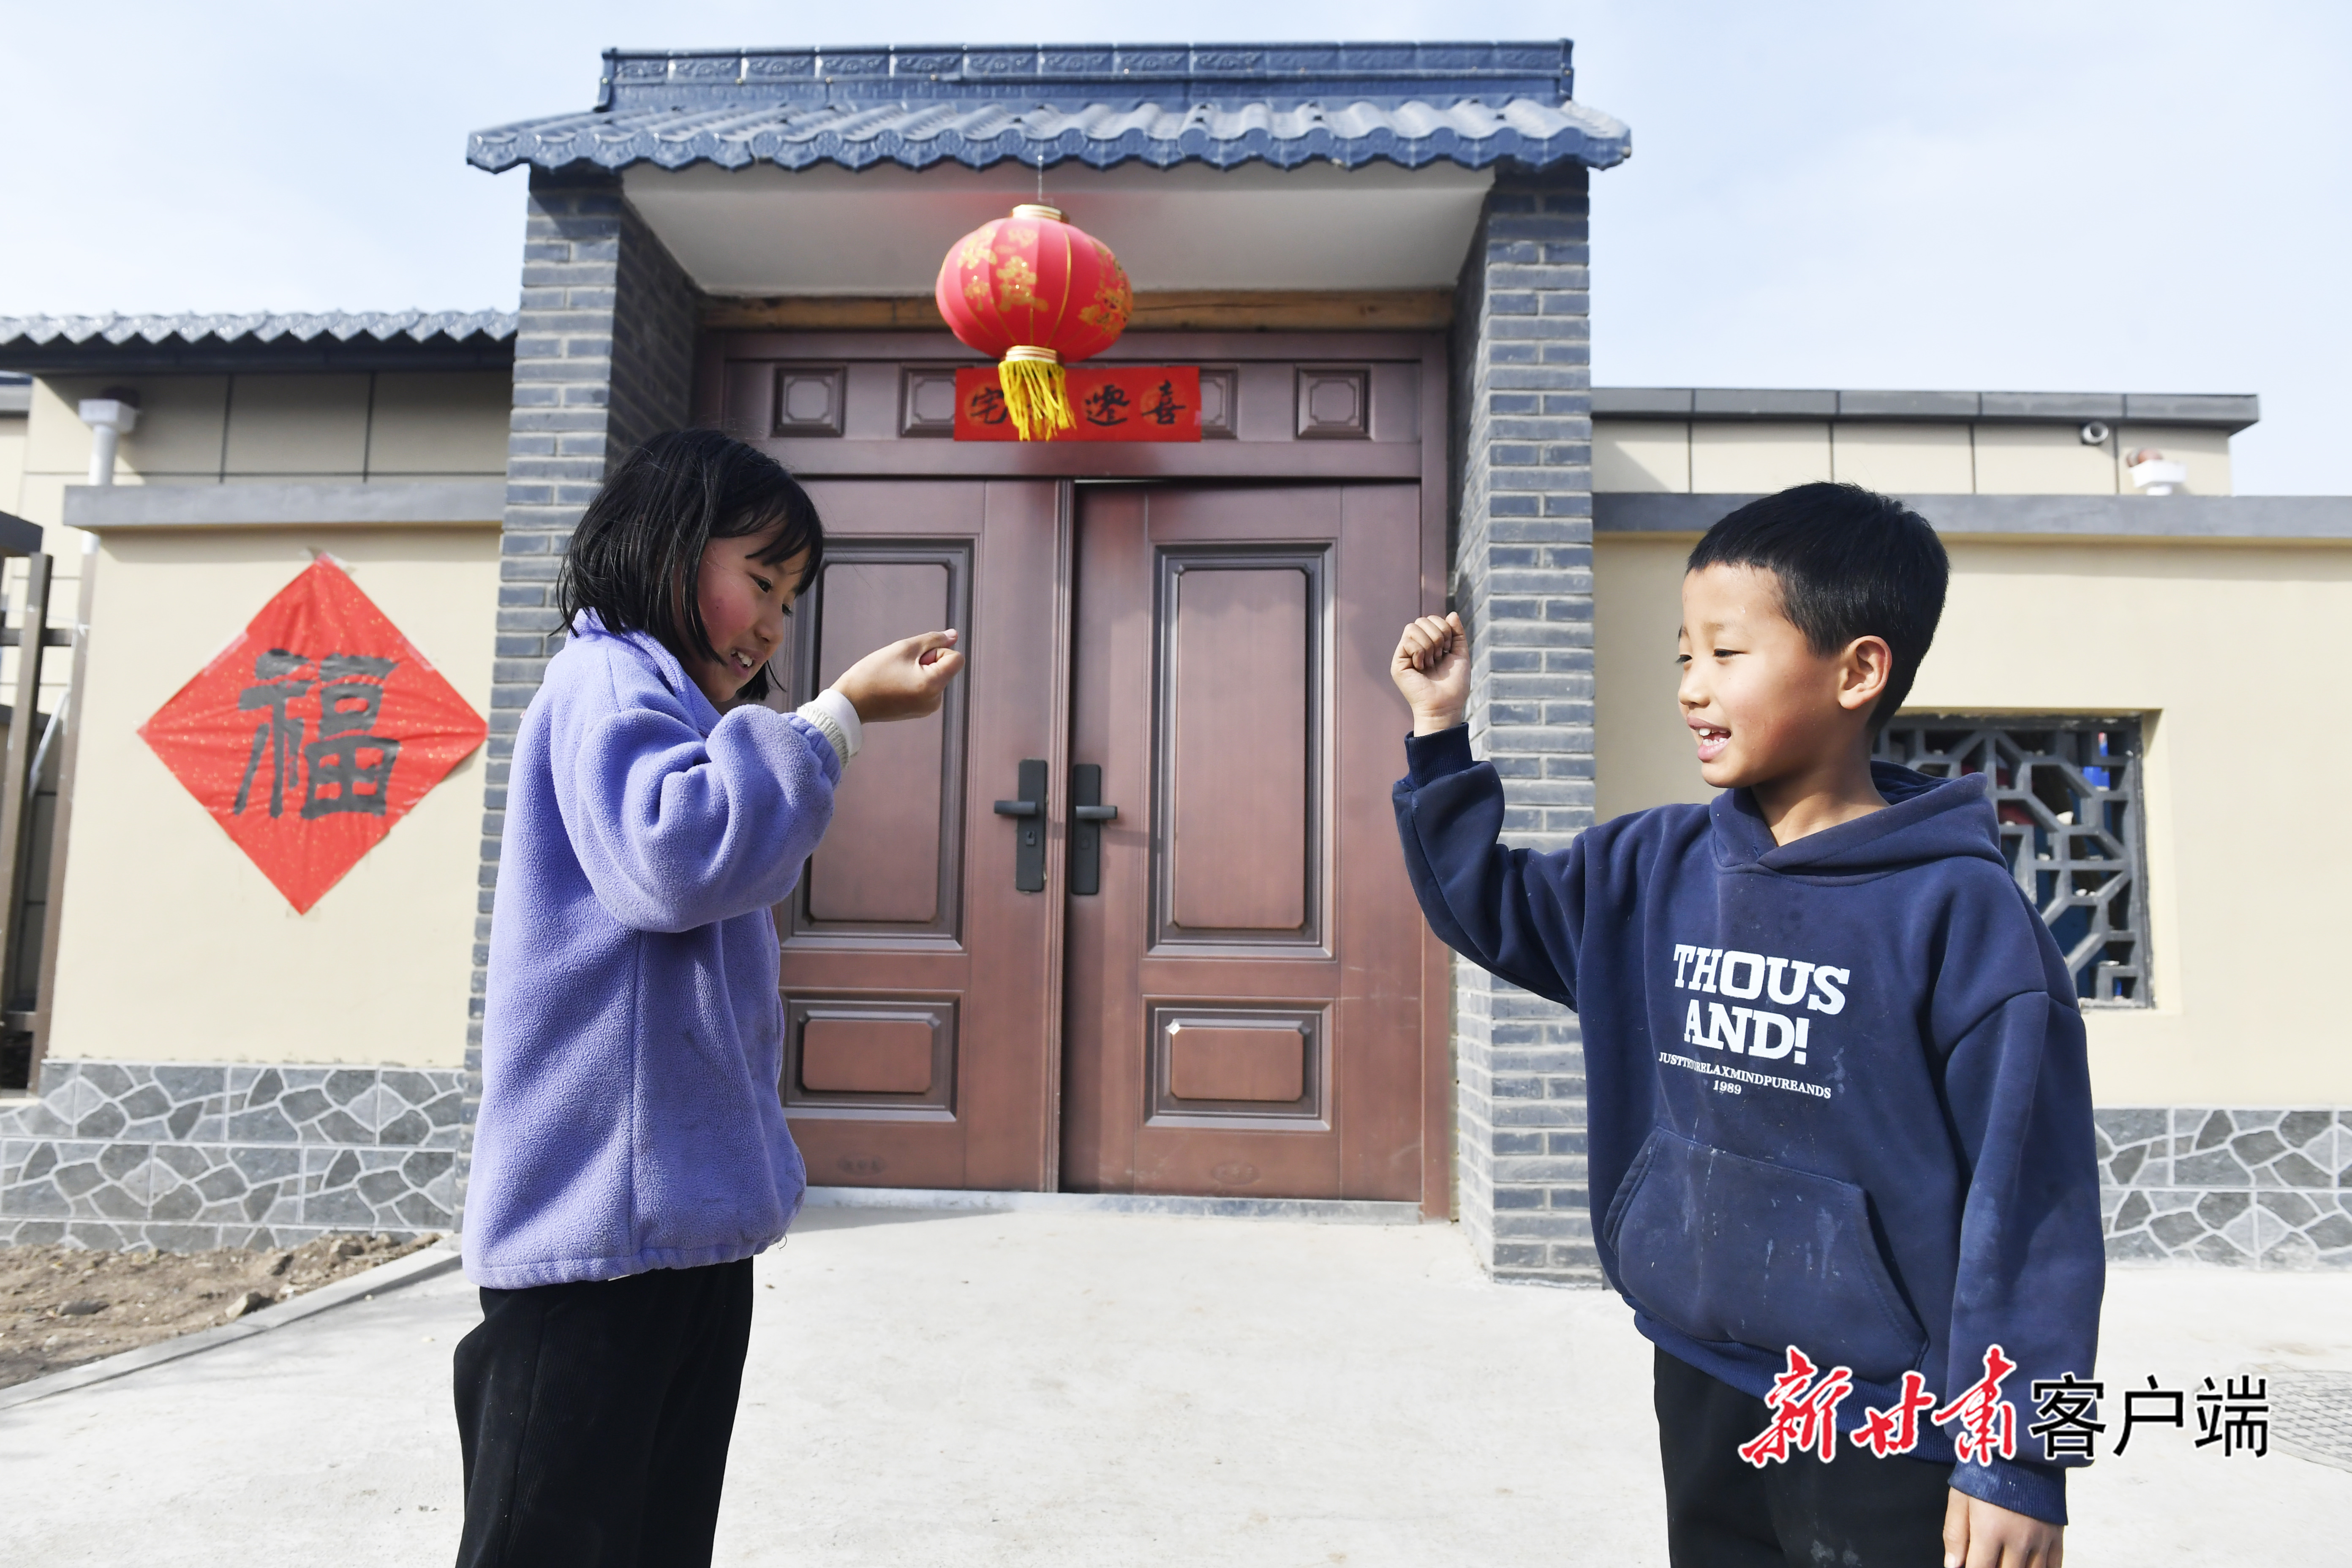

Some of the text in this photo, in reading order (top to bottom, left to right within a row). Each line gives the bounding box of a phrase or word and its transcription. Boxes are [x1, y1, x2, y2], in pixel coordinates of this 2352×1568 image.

[234, 648, 400, 820] 福
[1673, 944, 1851, 1015] THOUS
[1684, 999, 1810, 1065] AND!
[1712, 1080, 1742, 1095] 1989
